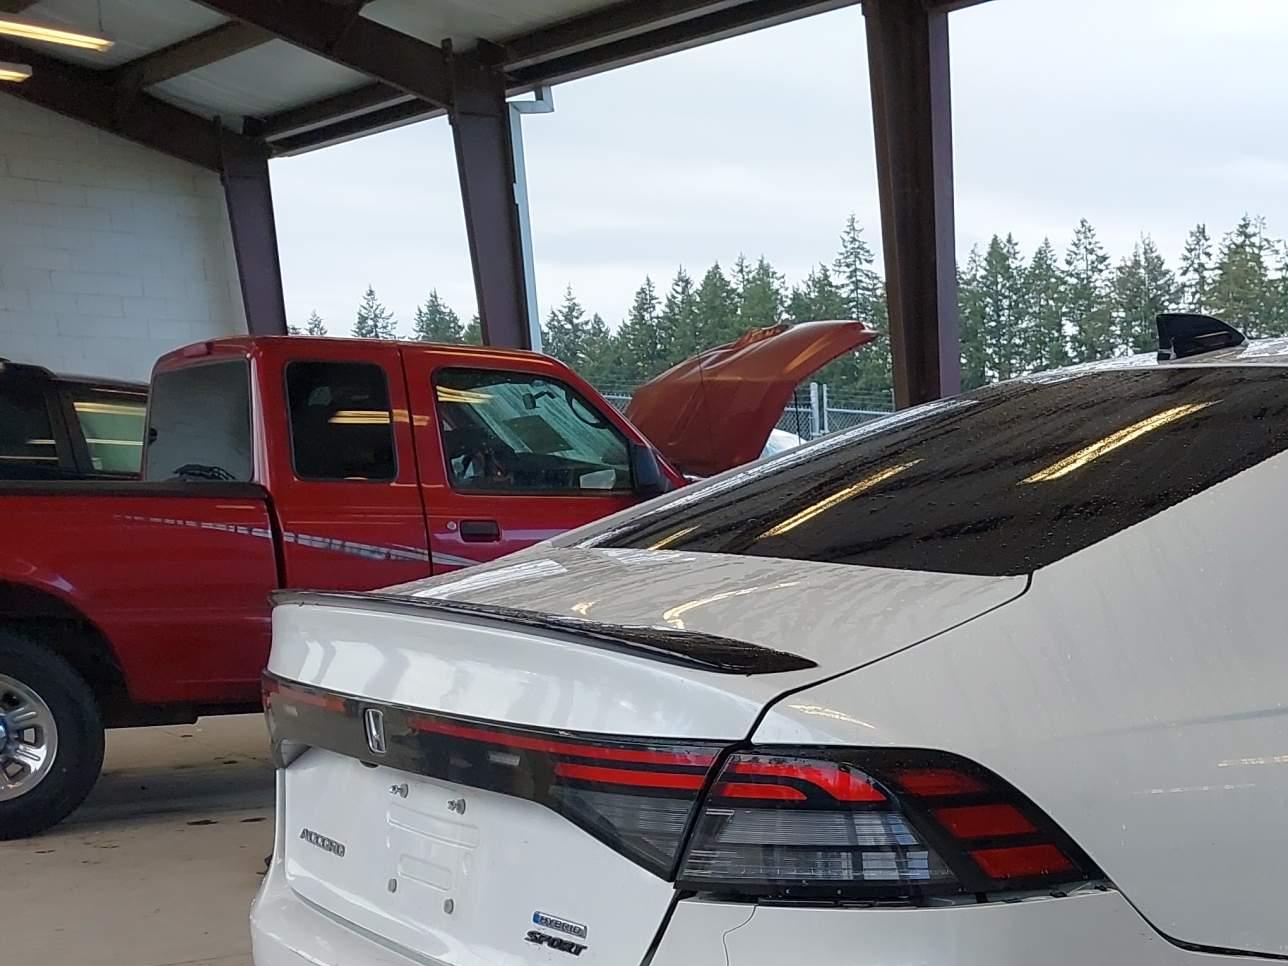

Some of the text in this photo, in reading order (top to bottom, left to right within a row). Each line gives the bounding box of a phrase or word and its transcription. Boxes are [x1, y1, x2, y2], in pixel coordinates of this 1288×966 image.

[299, 828, 346, 858] ACCORD
[539, 915, 581, 935] HYBRID
[524, 930, 588, 956] SPORT
